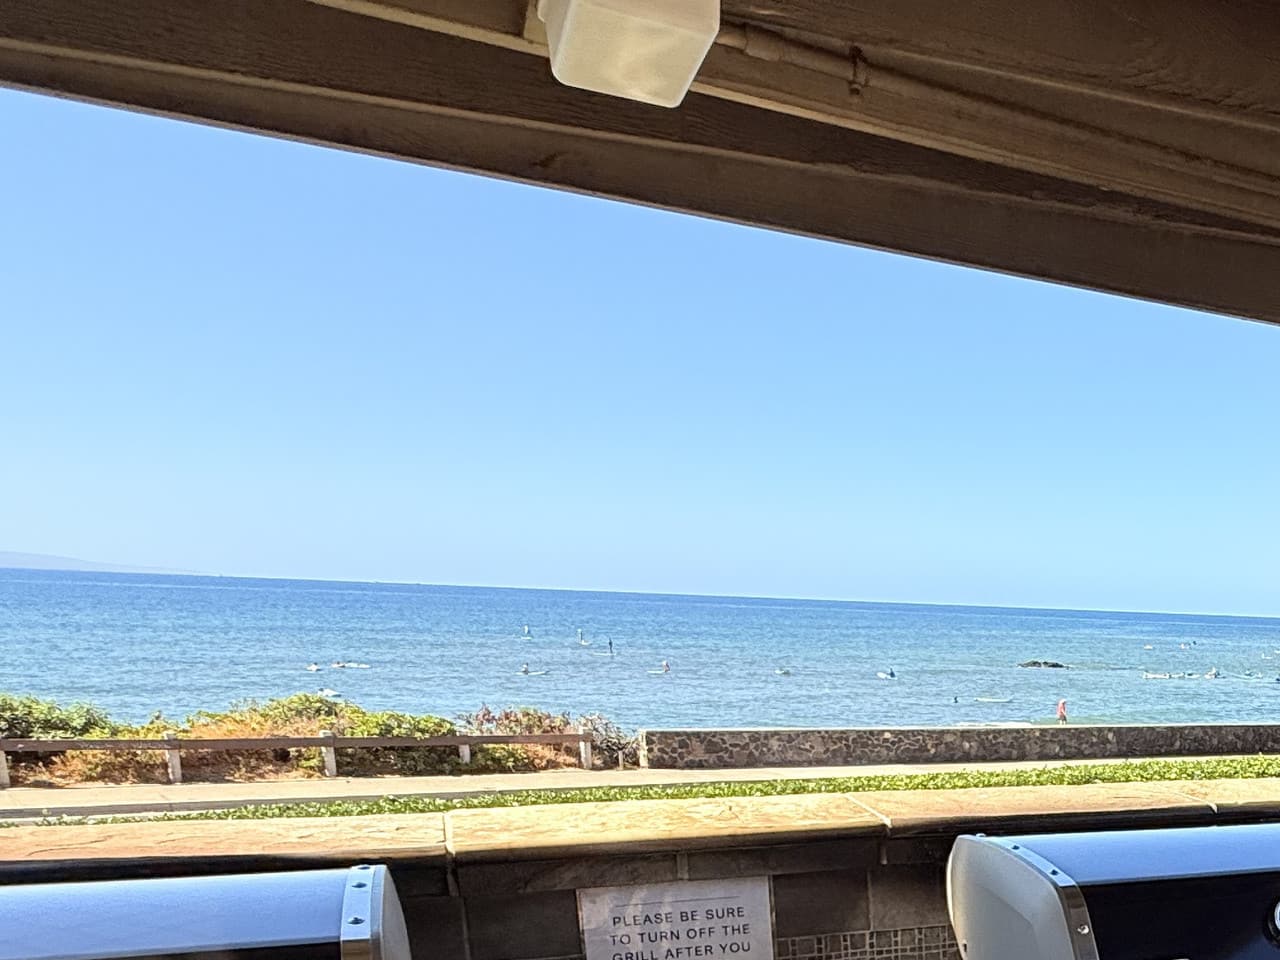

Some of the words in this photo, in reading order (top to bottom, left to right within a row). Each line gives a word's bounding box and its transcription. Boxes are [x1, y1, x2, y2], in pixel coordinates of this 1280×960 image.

[612, 911, 674, 927] PLEASE
[680, 910, 699, 923] BE
[705, 906, 745, 920] SURE
[609, 933, 631, 946] TO
[637, 929, 680, 943] TURN
[686, 926, 716, 940] OFF
[722, 923, 750, 937] THE
[665, 945, 714, 960] AFTER
[718, 941, 751, 954] YOU
